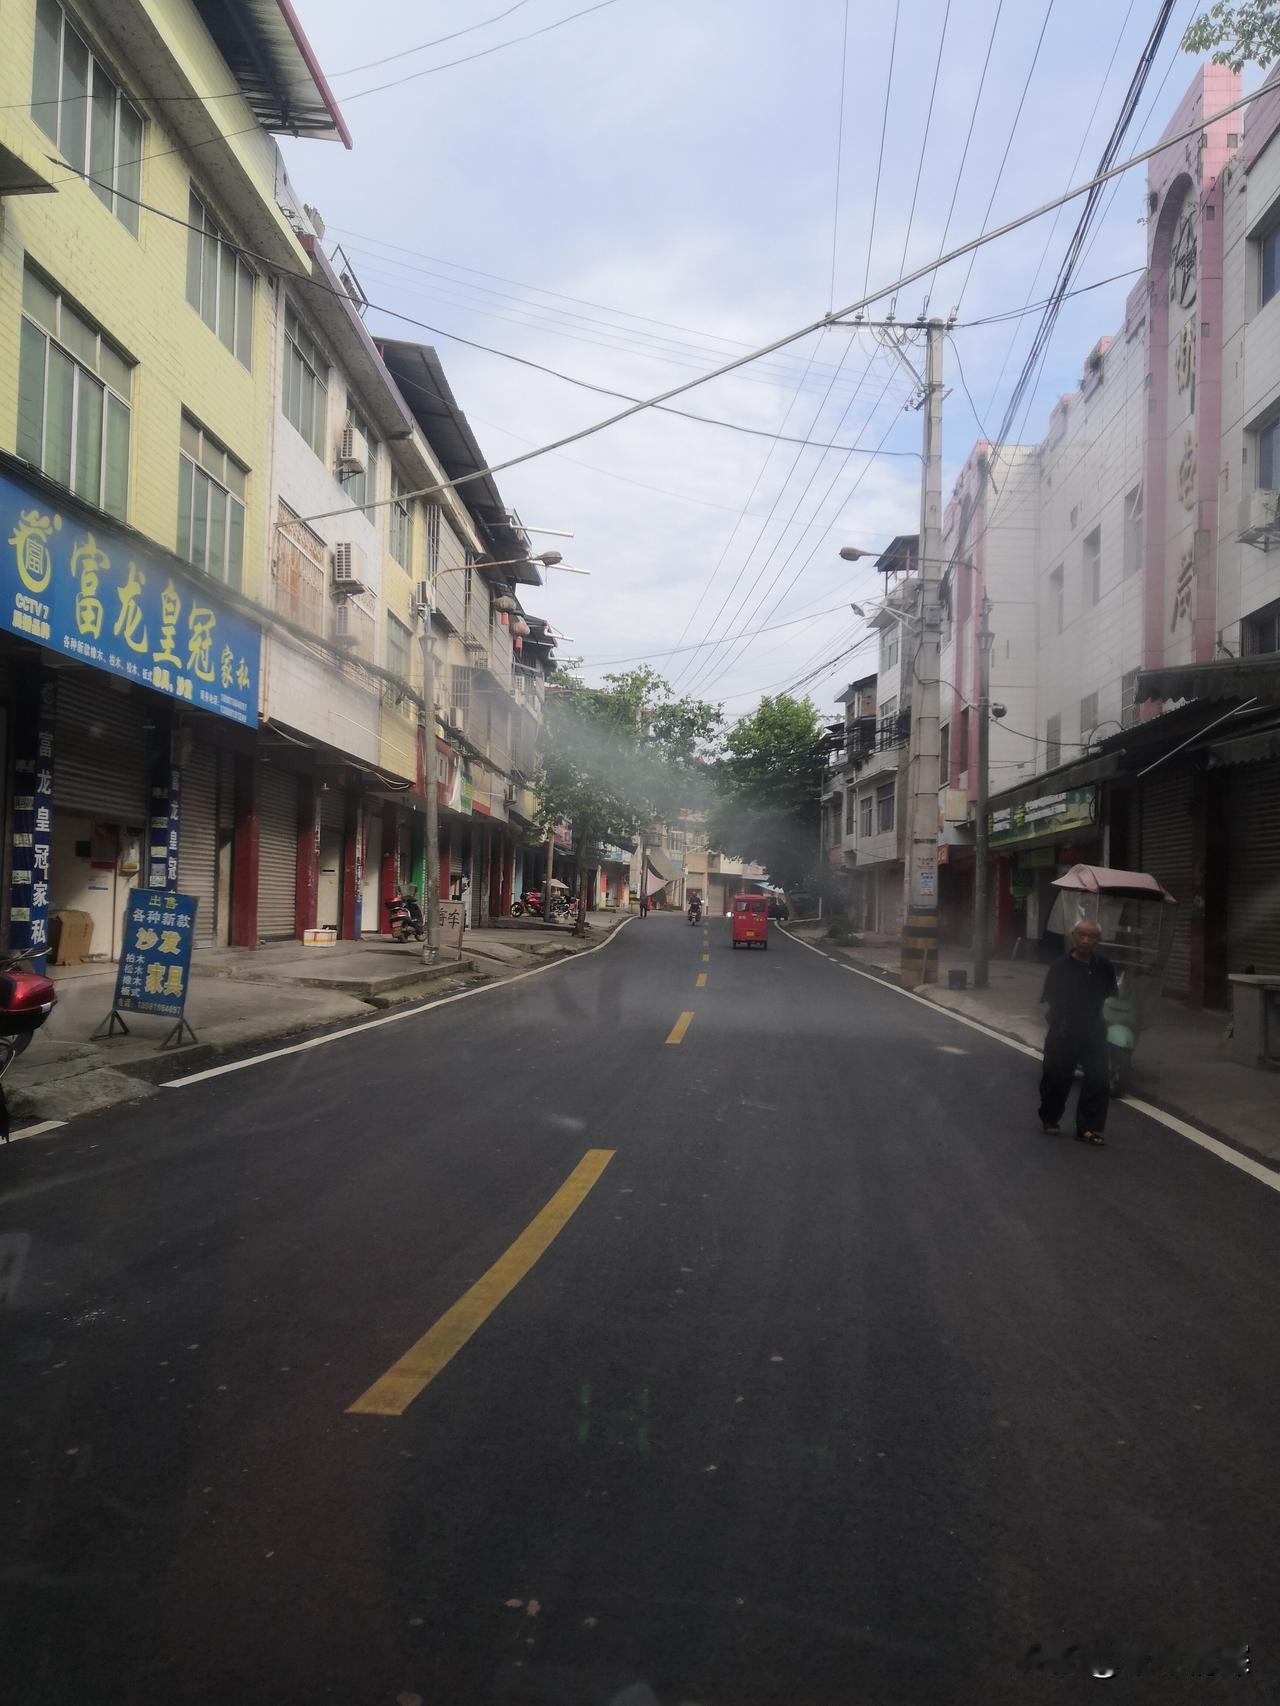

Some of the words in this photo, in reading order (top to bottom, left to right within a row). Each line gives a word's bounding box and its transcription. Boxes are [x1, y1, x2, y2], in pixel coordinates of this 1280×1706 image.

[148, 895, 179, 909] 出售
[132, 908, 191, 928] 各种新款
[135, 926, 182, 955] 沙发
[144, 962, 184, 998] 家具
